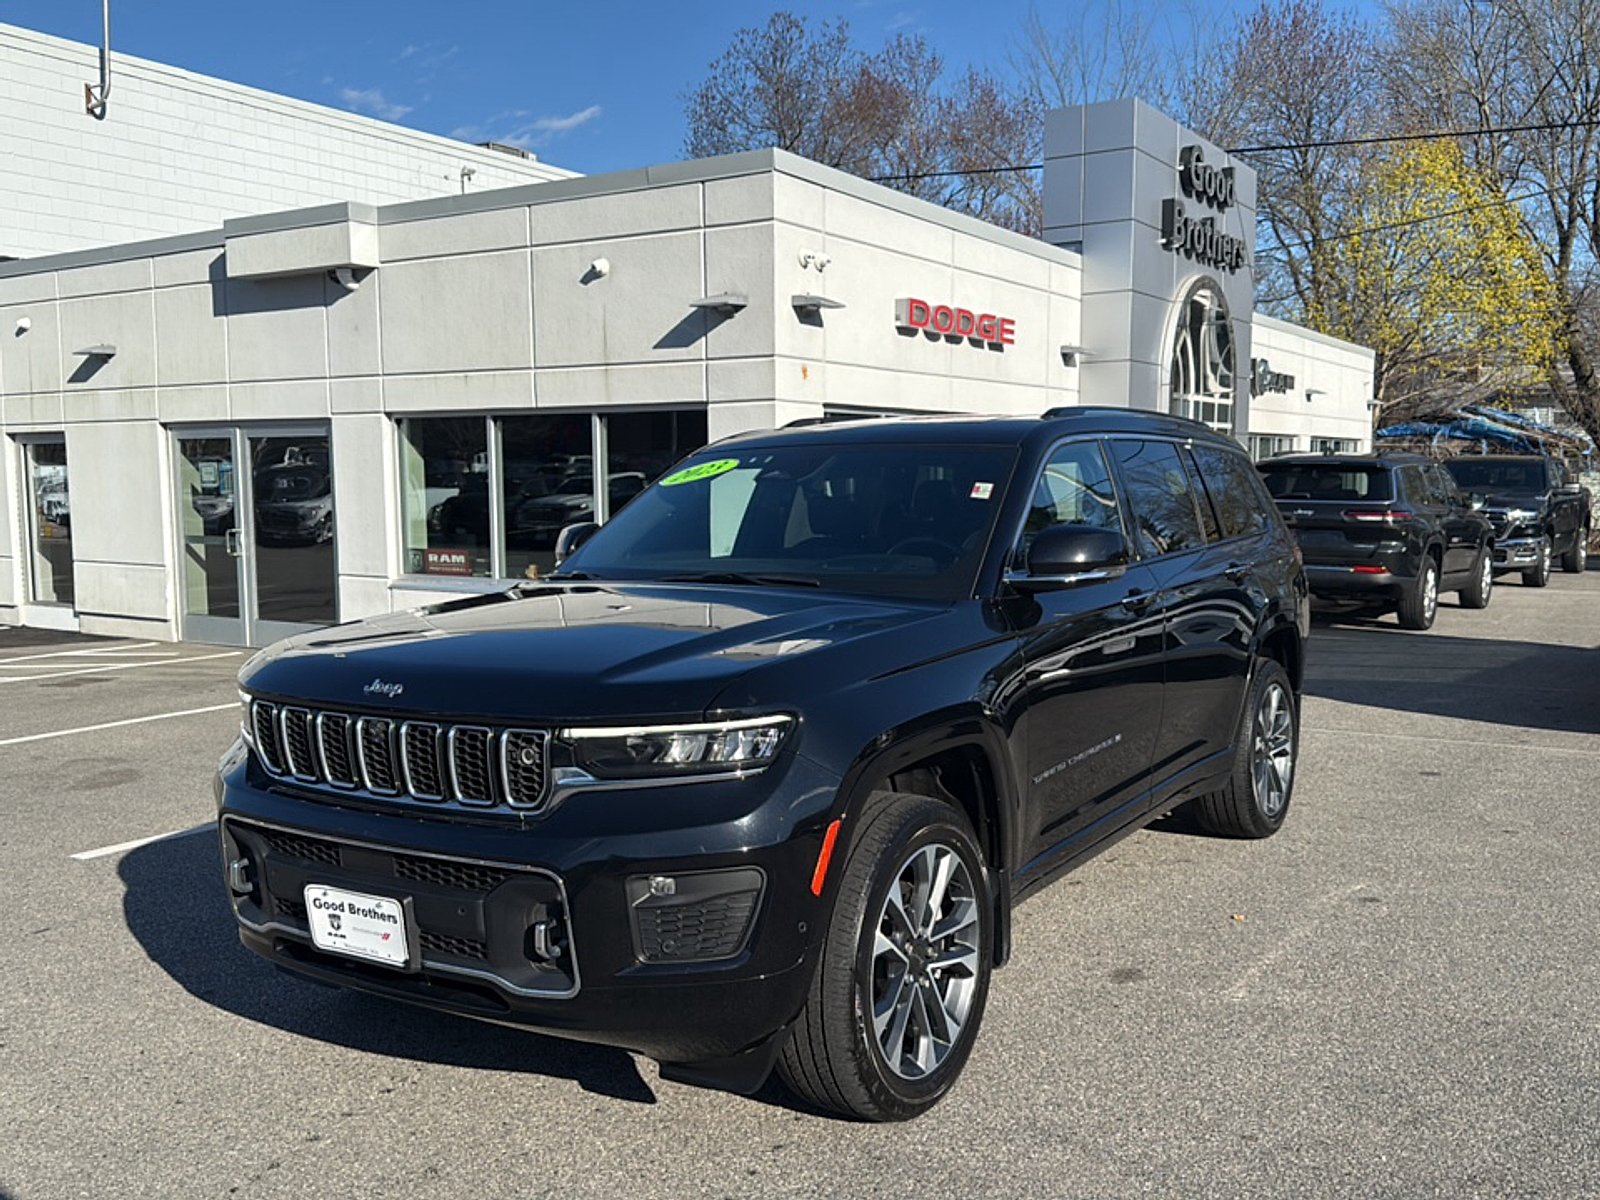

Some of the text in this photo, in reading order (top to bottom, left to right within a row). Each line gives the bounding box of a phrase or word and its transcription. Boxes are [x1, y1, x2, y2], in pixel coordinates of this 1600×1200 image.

[1182, 145, 1235, 208] Good
[1165, 199, 1245, 269] Brothers
[906, 298, 1015, 344] DODGE
[428, 553, 465, 564] RAM
[363, 678, 403, 698] Jeep
[312, 898, 398, 925] Good Brothers
